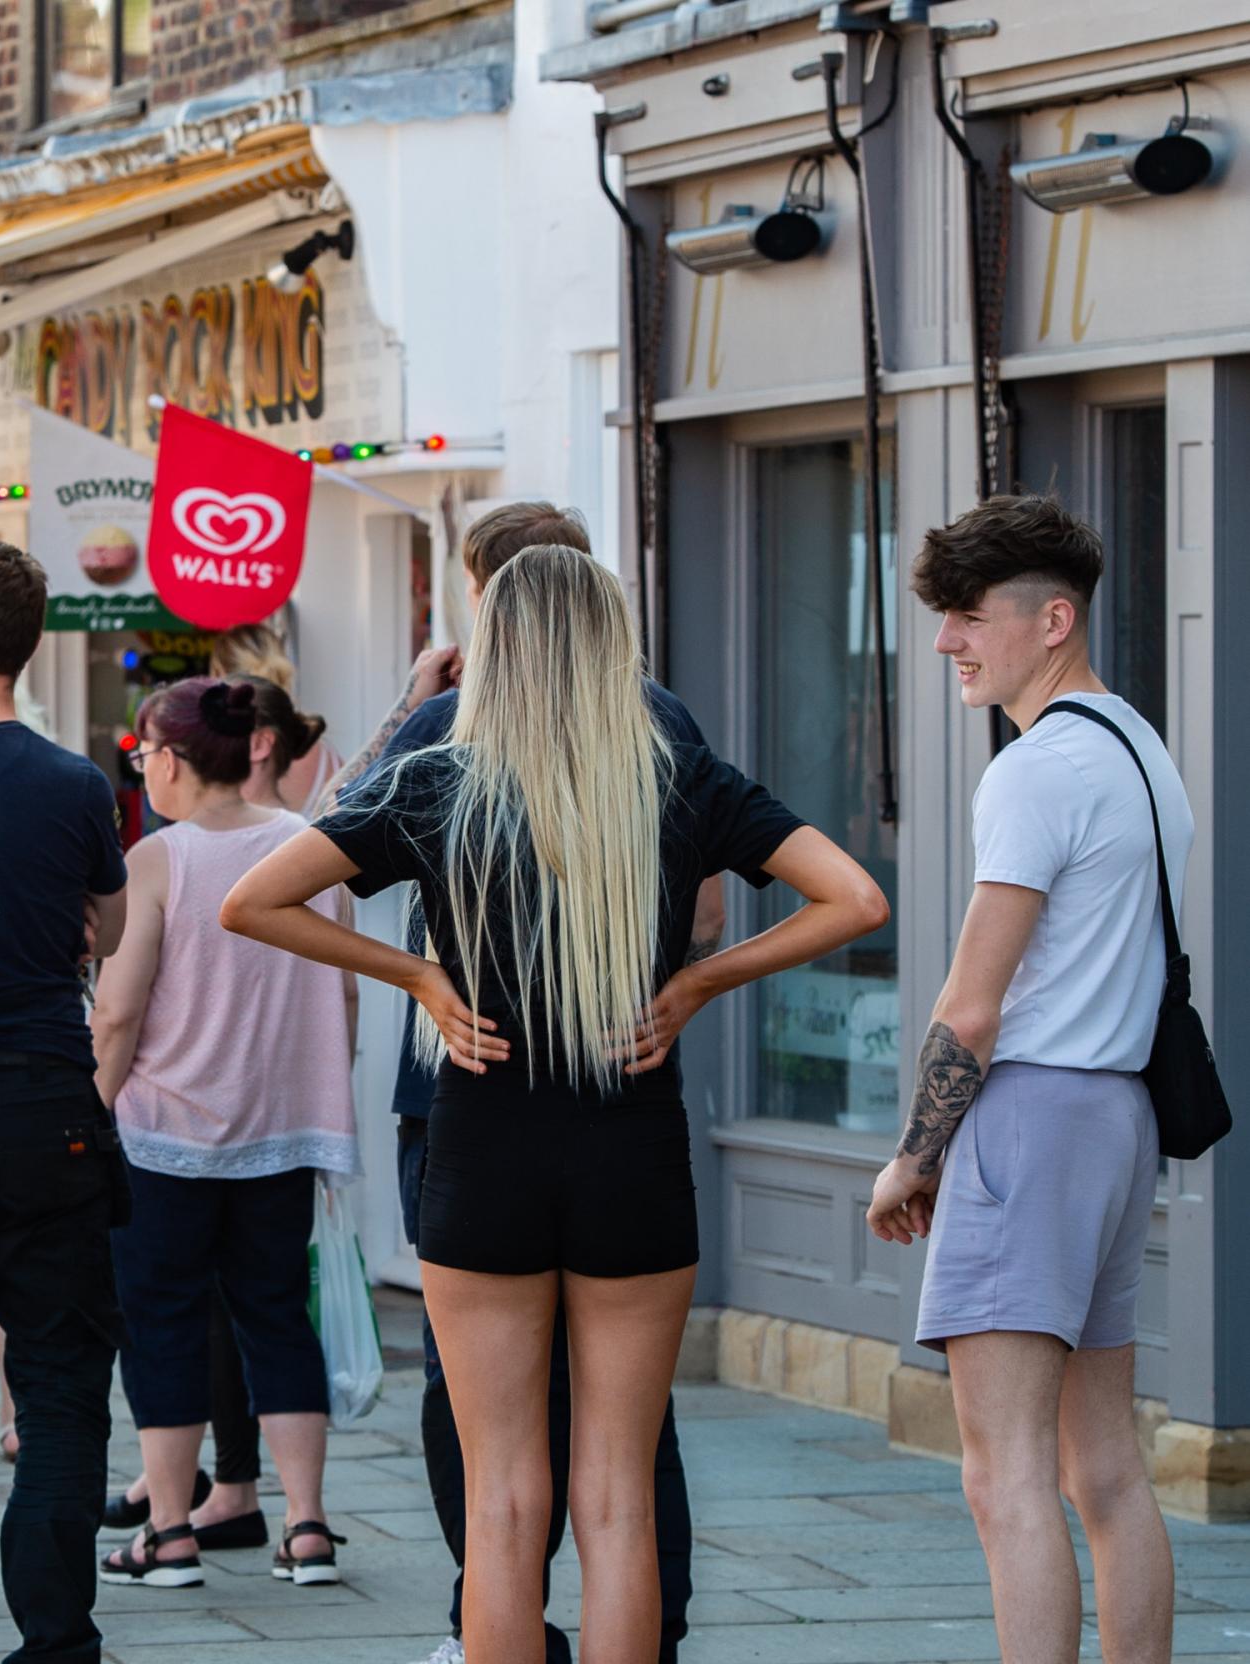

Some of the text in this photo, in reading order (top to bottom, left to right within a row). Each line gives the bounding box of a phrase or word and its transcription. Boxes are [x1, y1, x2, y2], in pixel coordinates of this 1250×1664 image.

[141, 283, 236, 442] ROCK
[241, 266, 325, 426] KING
[172, 553, 276, 590] WALL'S
